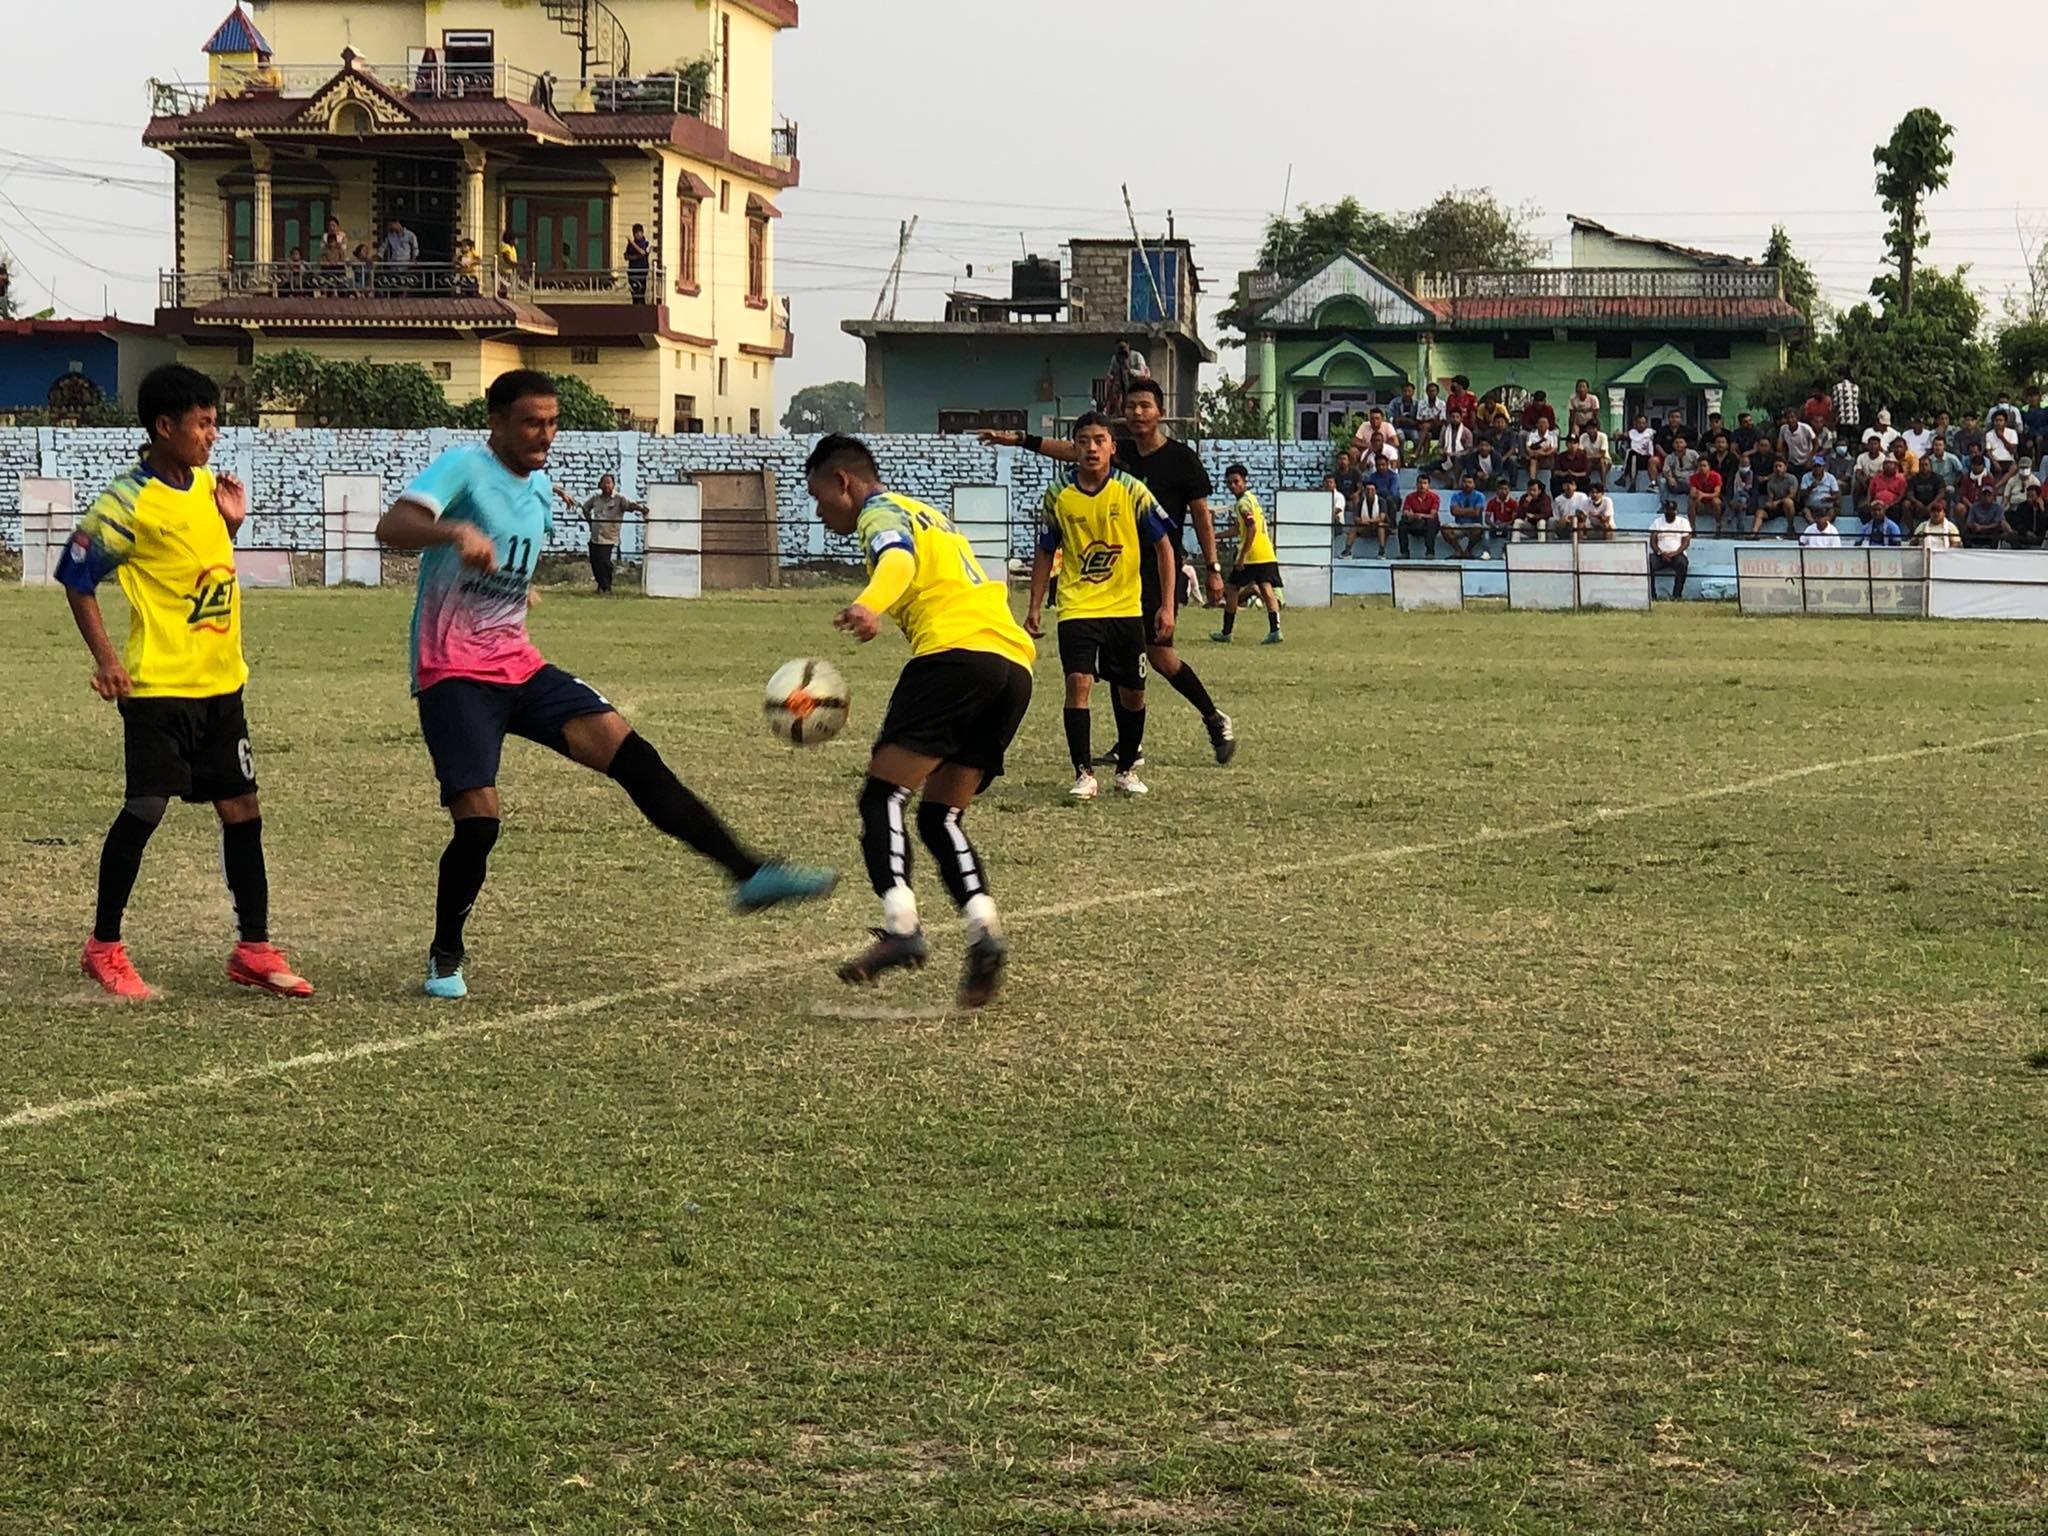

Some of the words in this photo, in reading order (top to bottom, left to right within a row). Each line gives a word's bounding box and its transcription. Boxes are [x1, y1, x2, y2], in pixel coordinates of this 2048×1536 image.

[502, 534, 531, 576] 11
[1138, 652, 1147, 679] 8
[237, 737, 255, 781] 6
